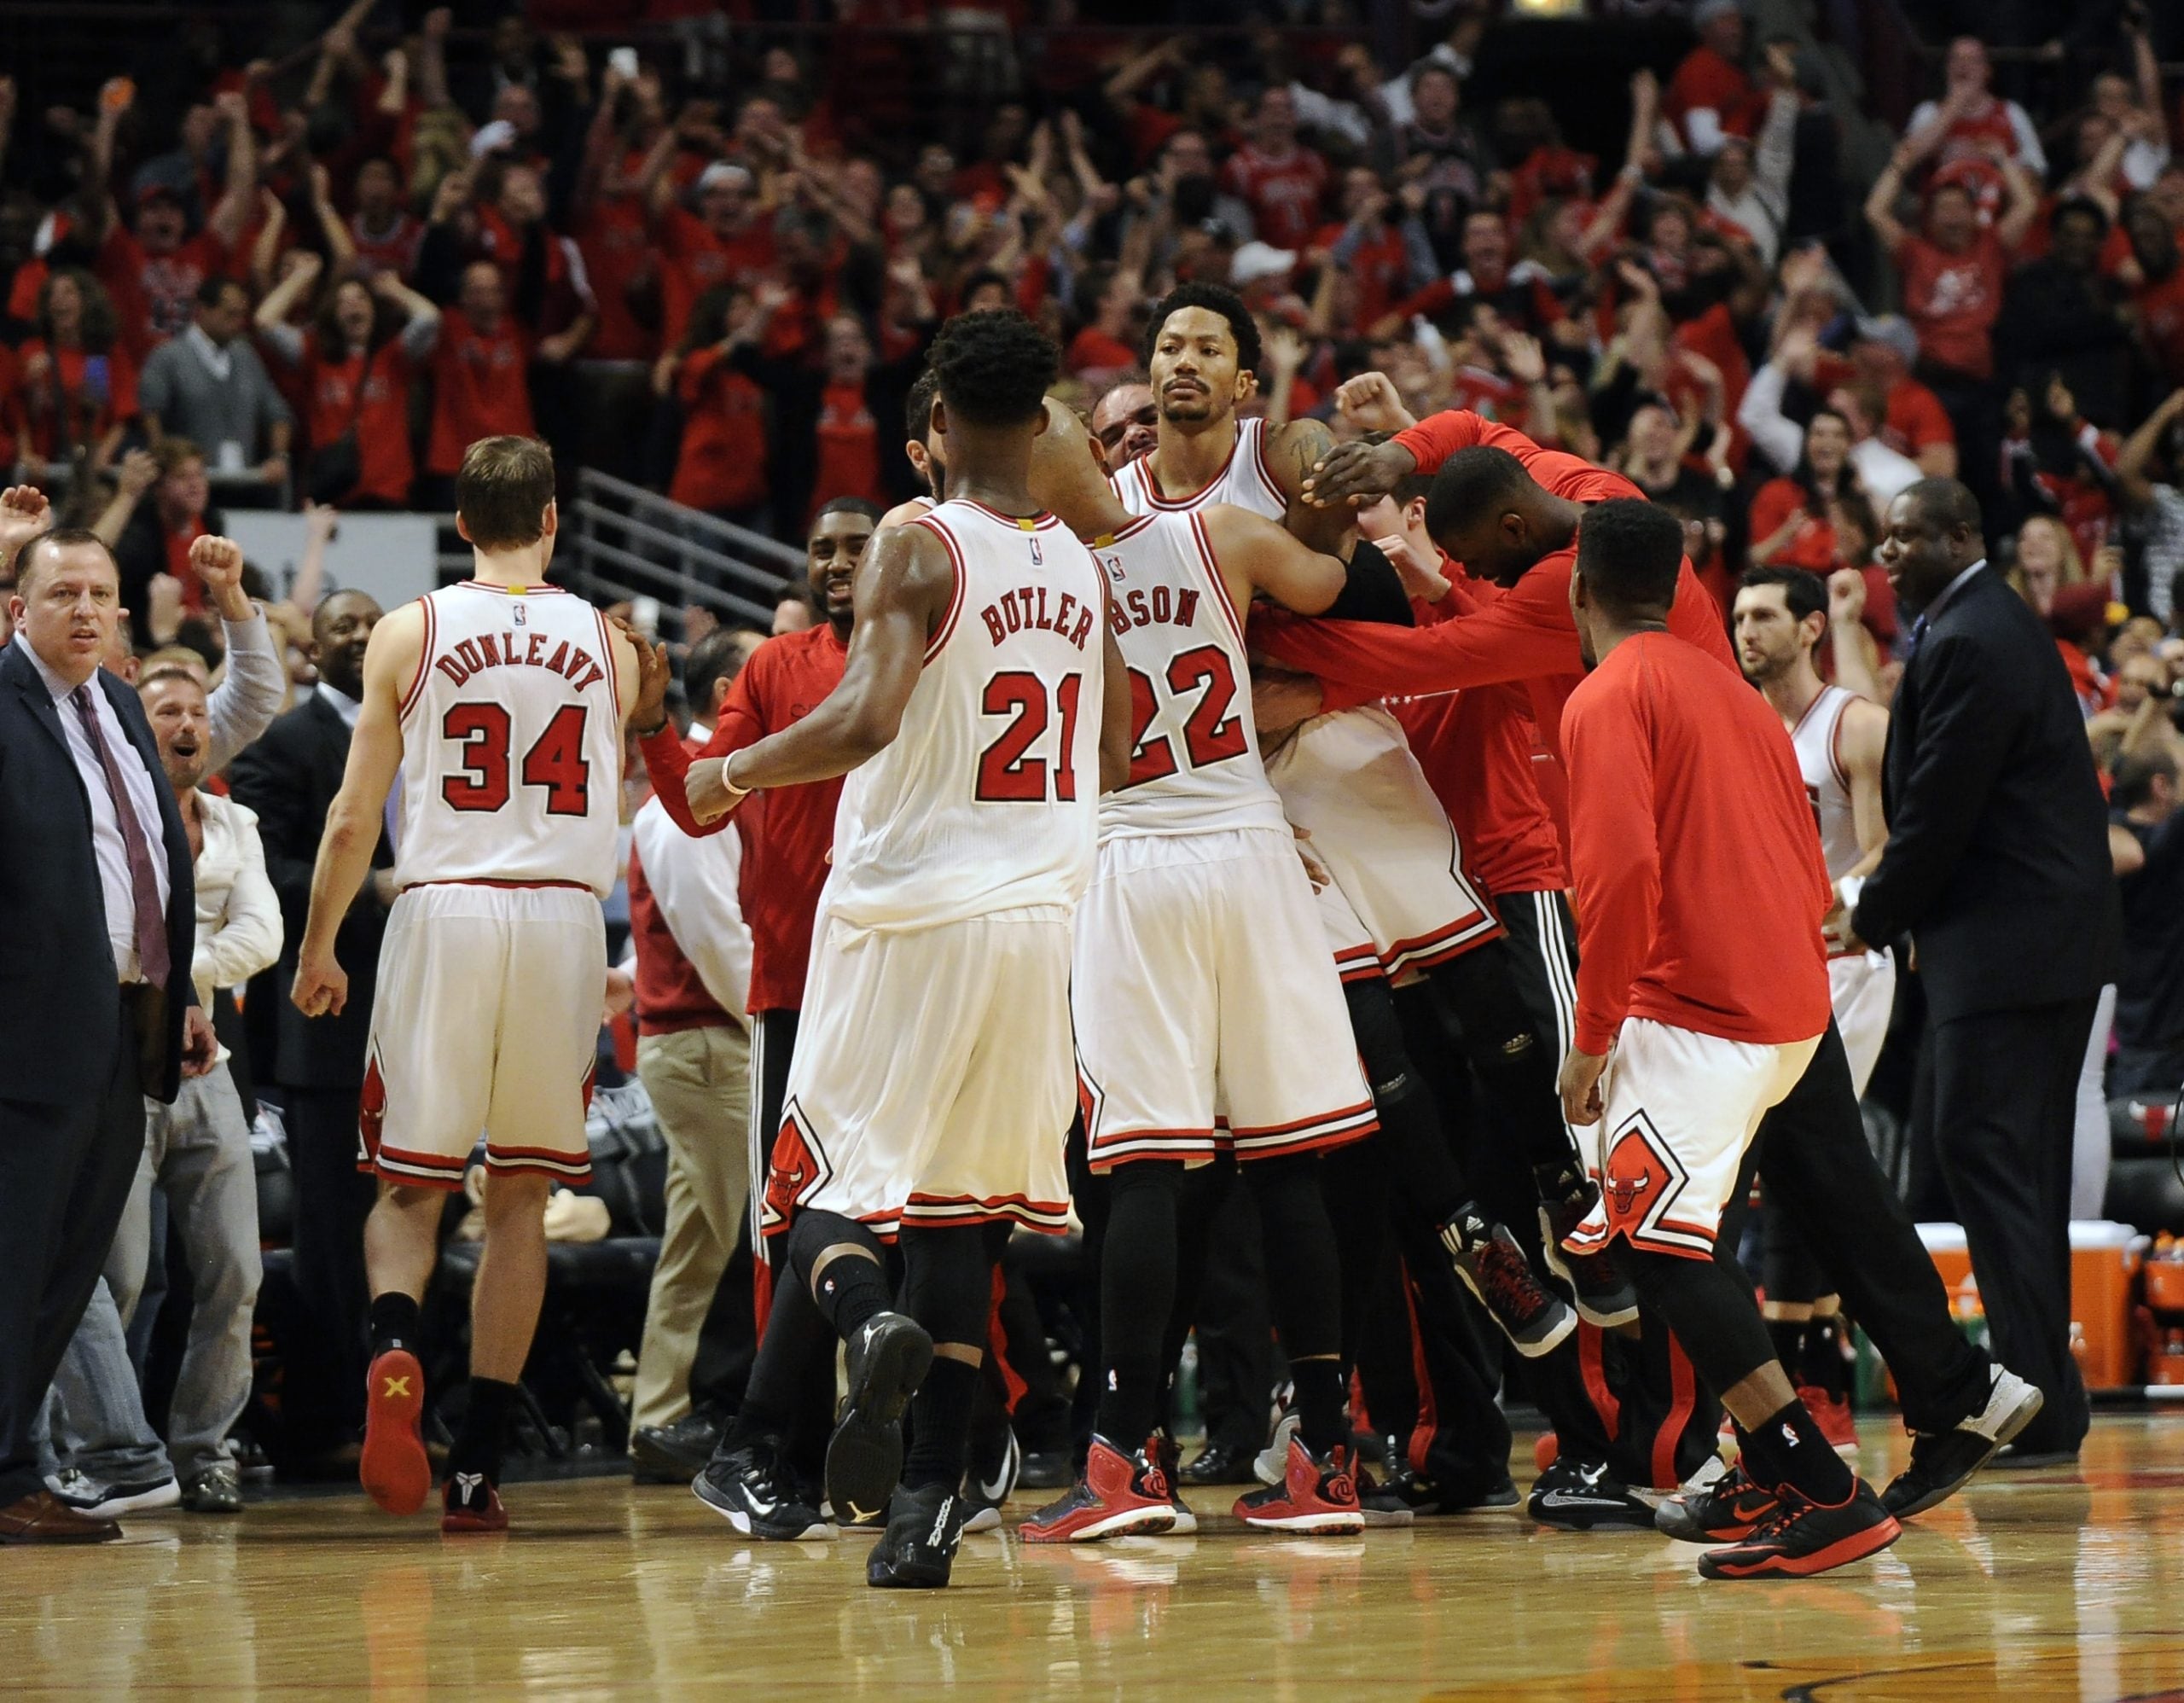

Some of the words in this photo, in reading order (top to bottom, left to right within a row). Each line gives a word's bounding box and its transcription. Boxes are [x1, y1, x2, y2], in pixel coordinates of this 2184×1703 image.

[435, 632, 604, 693] DUNLEAVY
[980, 586, 1094, 651] BUTLER
[442, 701, 590, 817] 34
[974, 670, 1082, 802] 21
[1112, 643, 1249, 793] 22
